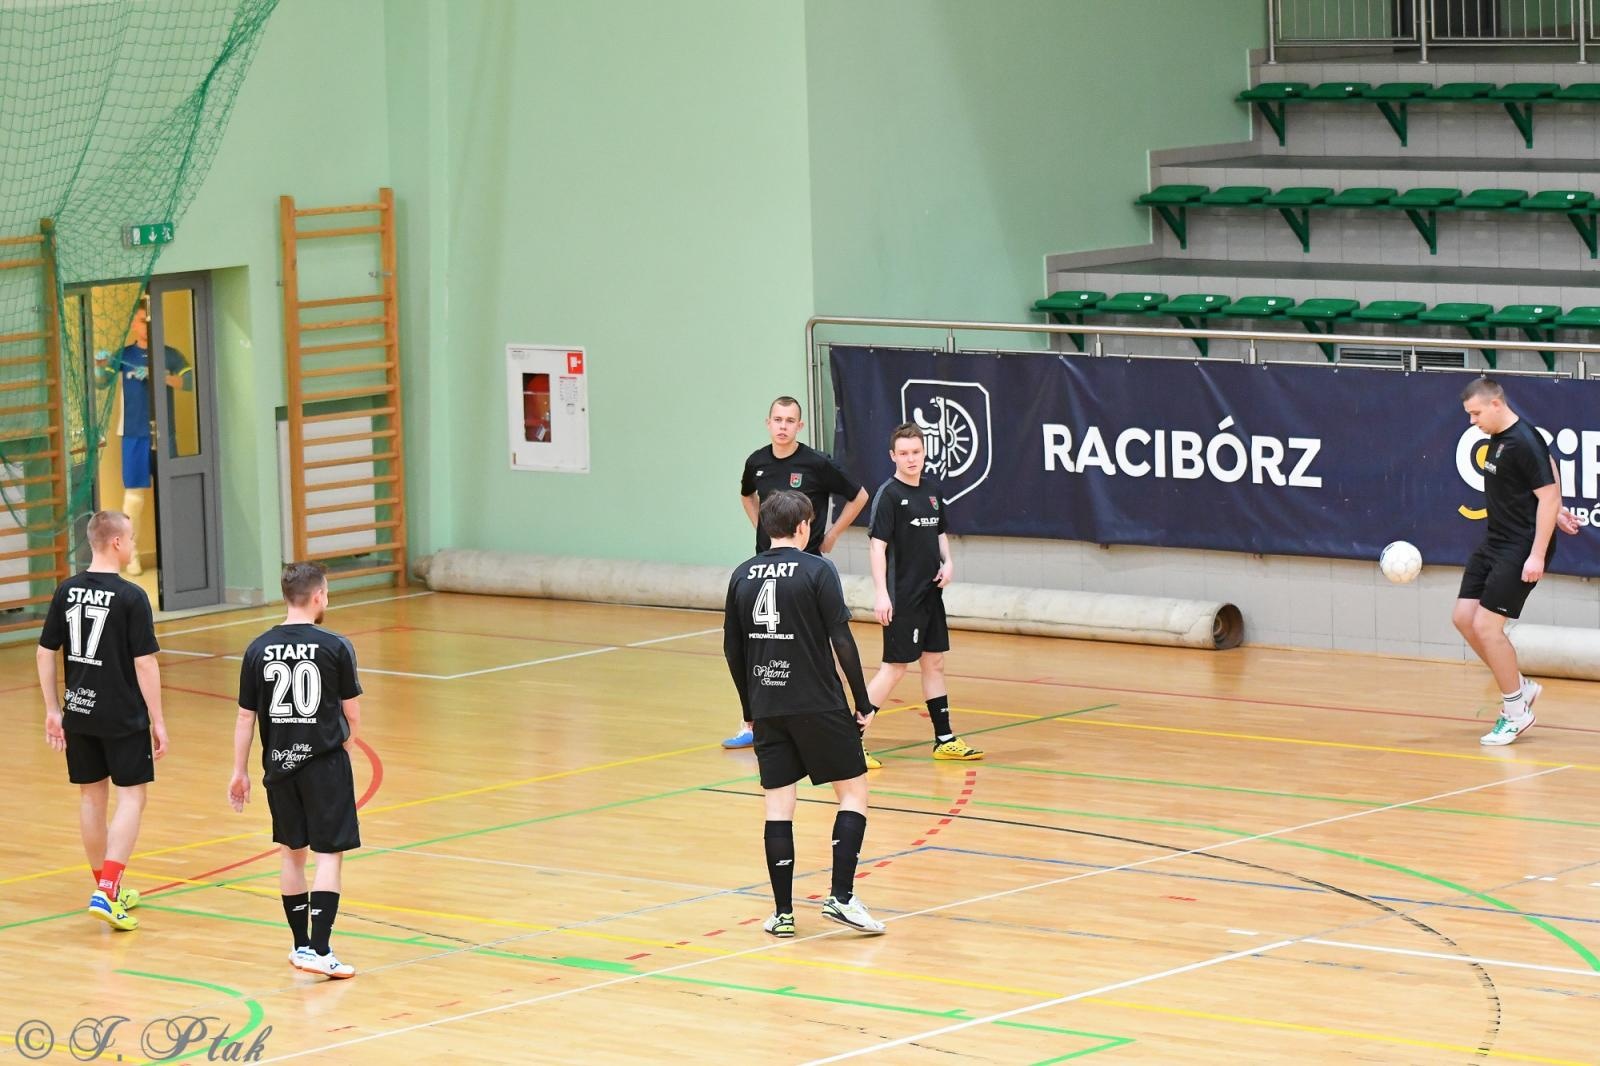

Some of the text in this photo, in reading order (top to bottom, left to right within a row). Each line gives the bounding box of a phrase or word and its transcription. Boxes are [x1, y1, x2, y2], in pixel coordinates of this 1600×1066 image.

[1042, 416, 1323, 489] RACIBÓRZ
[67, 587, 115, 606] START
[747, 562, 799, 580] START
[65, 604, 110, 658] 17
[752, 579, 780, 633] 4
[263, 644, 319, 661] START
[263, 660, 321, 718] 20
